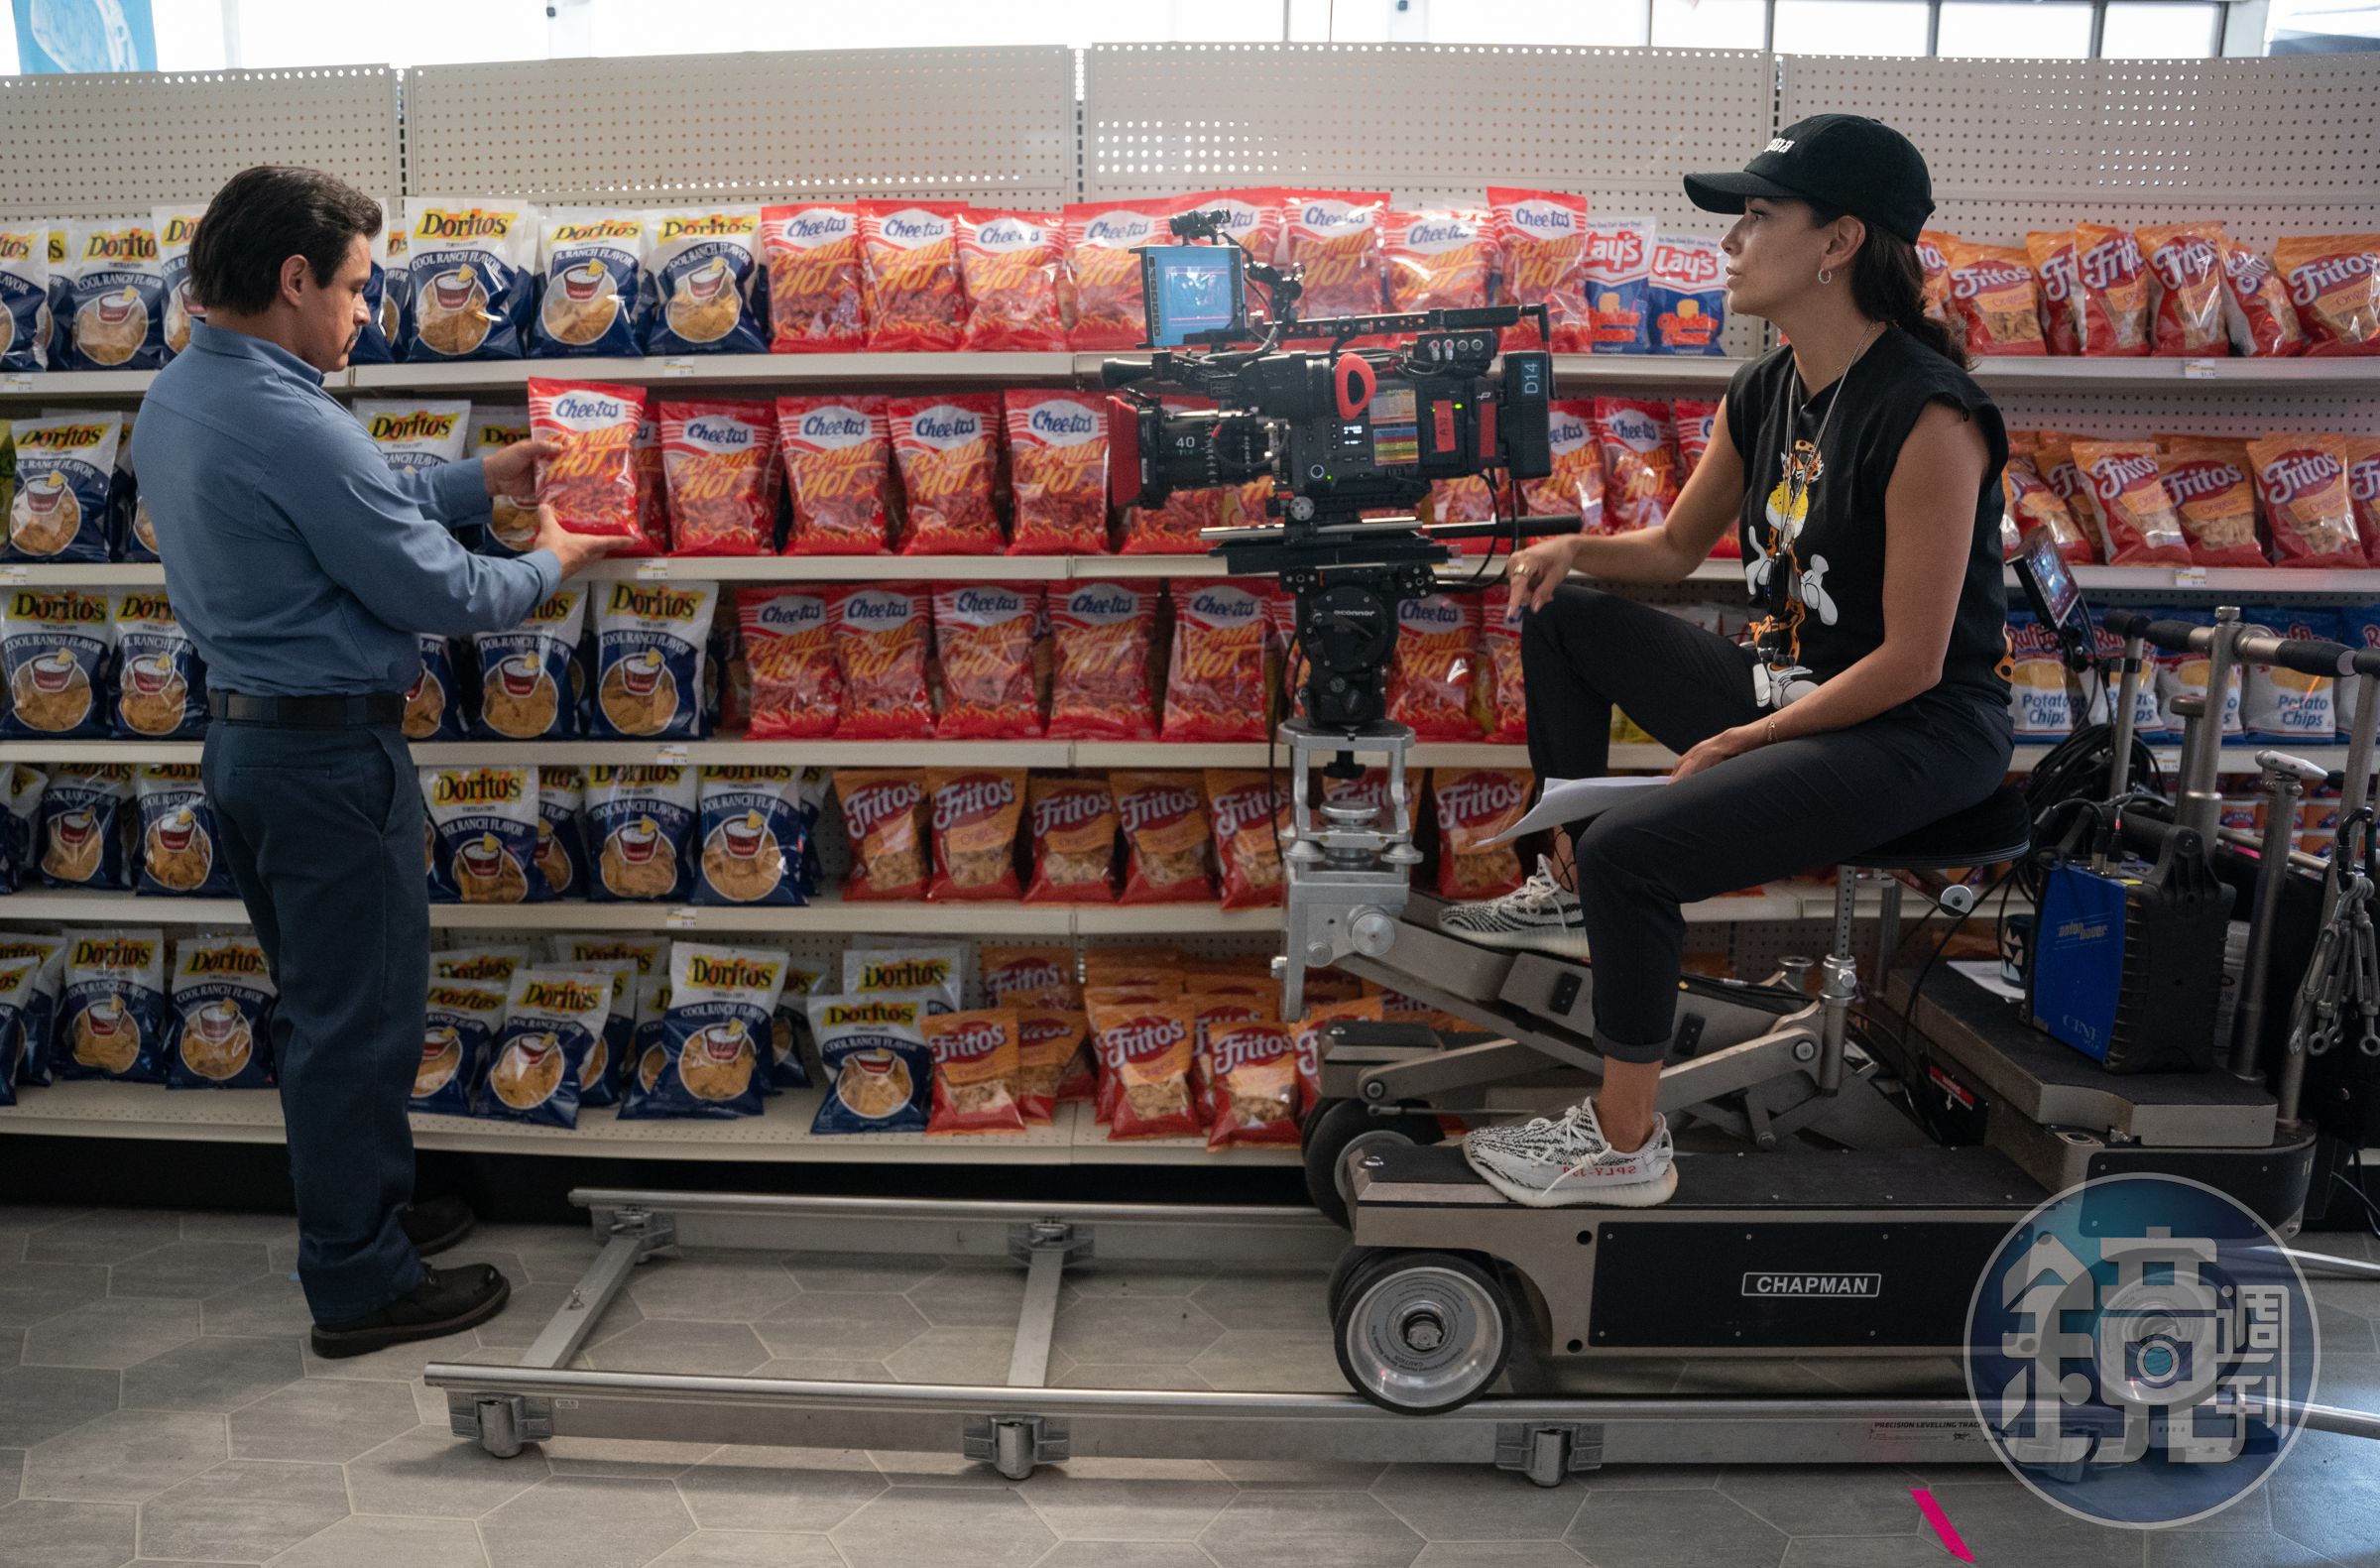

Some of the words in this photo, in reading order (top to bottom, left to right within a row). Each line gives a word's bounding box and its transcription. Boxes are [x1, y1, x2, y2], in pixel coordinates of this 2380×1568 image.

[421, 211, 508, 238] Doritos
[555, 221, 639, 241] Doritos
[663, 215, 754, 239] Doritos
[88, 228, 157, 258] Dorito
[572, 248, 597, 259] RANCH
[598, 247, 634, 268] FLAVOR
[666, 250, 694, 273] COOL
[695, 243, 721, 258] RANCH
[722, 243, 751, 266] FLAVOR
[412, 252, 435, 273] COOL
[436, 250, 469, 264] RANCH
[469, 251, 502, 275] FLAVOR
[880, 257, 958, 292] HOT
[1654, 247, 1718, 282] Lay's
[2150, 237, 2217, 292] Fritos
[2288, 250, 2379, 304] Fritos
[101, 273, 132, 288] RANCH
[776, 257, 859, 299] HOT
[1951, 264, 2033, 300] Fritos
[1524, 363, 1539, 395] D14
[20, 425, 102, 448] Doritos
[371, 412, 451, 439] Doritos
[906, 437, 989, 474] FLAMIN
[1176, 436, 1196, 448] 40
[28, 460, 60, 470] RANCH
[61, 459, 95, 480] FLAVOR
[545, 442, 633, 482] HOT
[794, 442, 878, 475] FLAMIN
[678, 466, 762, 503] HOT
[799, 460, 887, 498] HOT
[917, 461, 992, 500] HOT
[1033, 459, 1107, 493] HOT
[2091, 453, 2158, 501] Fritos
[2162, 461, 2244, 507] Fritos
[2262, 451, 2344, 505] Fritos
[15, 593, 107, 623] Doritos
[613, 583, 697, 619] Doritos
[33, 633, 66, 646] RANCH
[67, 635, 102, 654] FLAVOR
[134, 635, 167, 647] RANCH
[602, 632, 625, 646] COOL
[626, 631, 655, 646] RANCH
[655, 633, 690, 656] FLAVOR
[2029, 708, 2066, 727] Chips
[2278, 694, 2328, 711] Potato
[2283, 708, 2323, 728] Chips
[438, 773, 521, 801] Doritos
[615, 799, 646, 814] RANCH
[646, 800, 684, 820] FLAVOR
[725, 795, 754, 808] RANCH
[755, 797, 788, 817] FLAVOR
[843, 781, 921, 840] Fritos
[931, 778, 1015, 831] Fritos
[1032, 790, 1112, 838] Fritos
[1118, 784, 1201, 835] Fritos
[1437, 777, 1524, 830] Fritos
[463, 818, 488, 831] RANCH
[489, 818, 524, 836] FLAVOR
[75, 939, 149, 969] Doritos
[191, 947, 266, 975] Doritos
[693, 956, 773, 989] Doritos
[864, 960, 946, 989] Doritos
[177, 989, 202, 1002] COOL
[204, 985, 234, 998] RANCH
[234, 988, 265, 1003] FLAVOR
[524, 980, 597, 1012] Doritos
[681, 1005, 706, 1019] COOL
[707, 1002, 737, 1016] RANCH
[829, 1002, 914, 1025] Doritos
[847, 1037, 879, 1049] RANCH
[929, 1024, 1006, 1063] Fritos
[1105, 1018, 1187, 1068] Fritos
[1213, 1030, 1294, 1075] Fritos
[1756, 1275, 1868, 1293] CHAPMAN
